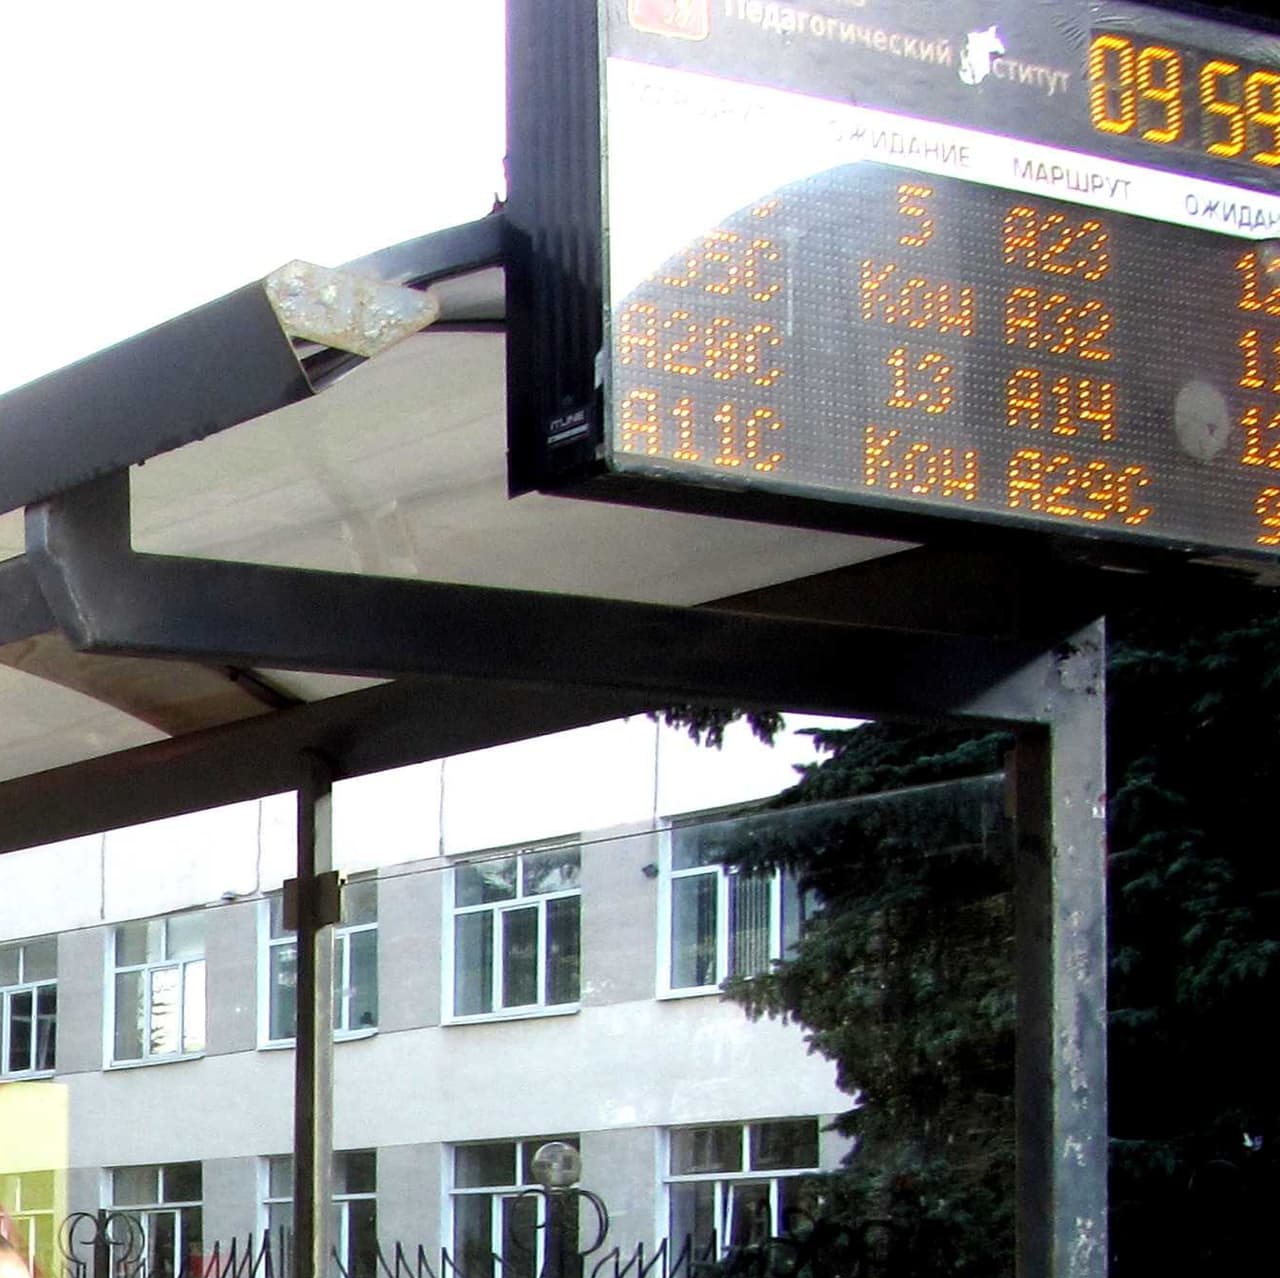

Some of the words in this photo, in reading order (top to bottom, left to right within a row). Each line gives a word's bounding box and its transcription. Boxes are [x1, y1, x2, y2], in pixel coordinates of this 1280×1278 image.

[1012, 157, 1132, 200] МАРШРУТ
[897, 184, 933, 247] 5
[887, 347, 952, 414] 13
